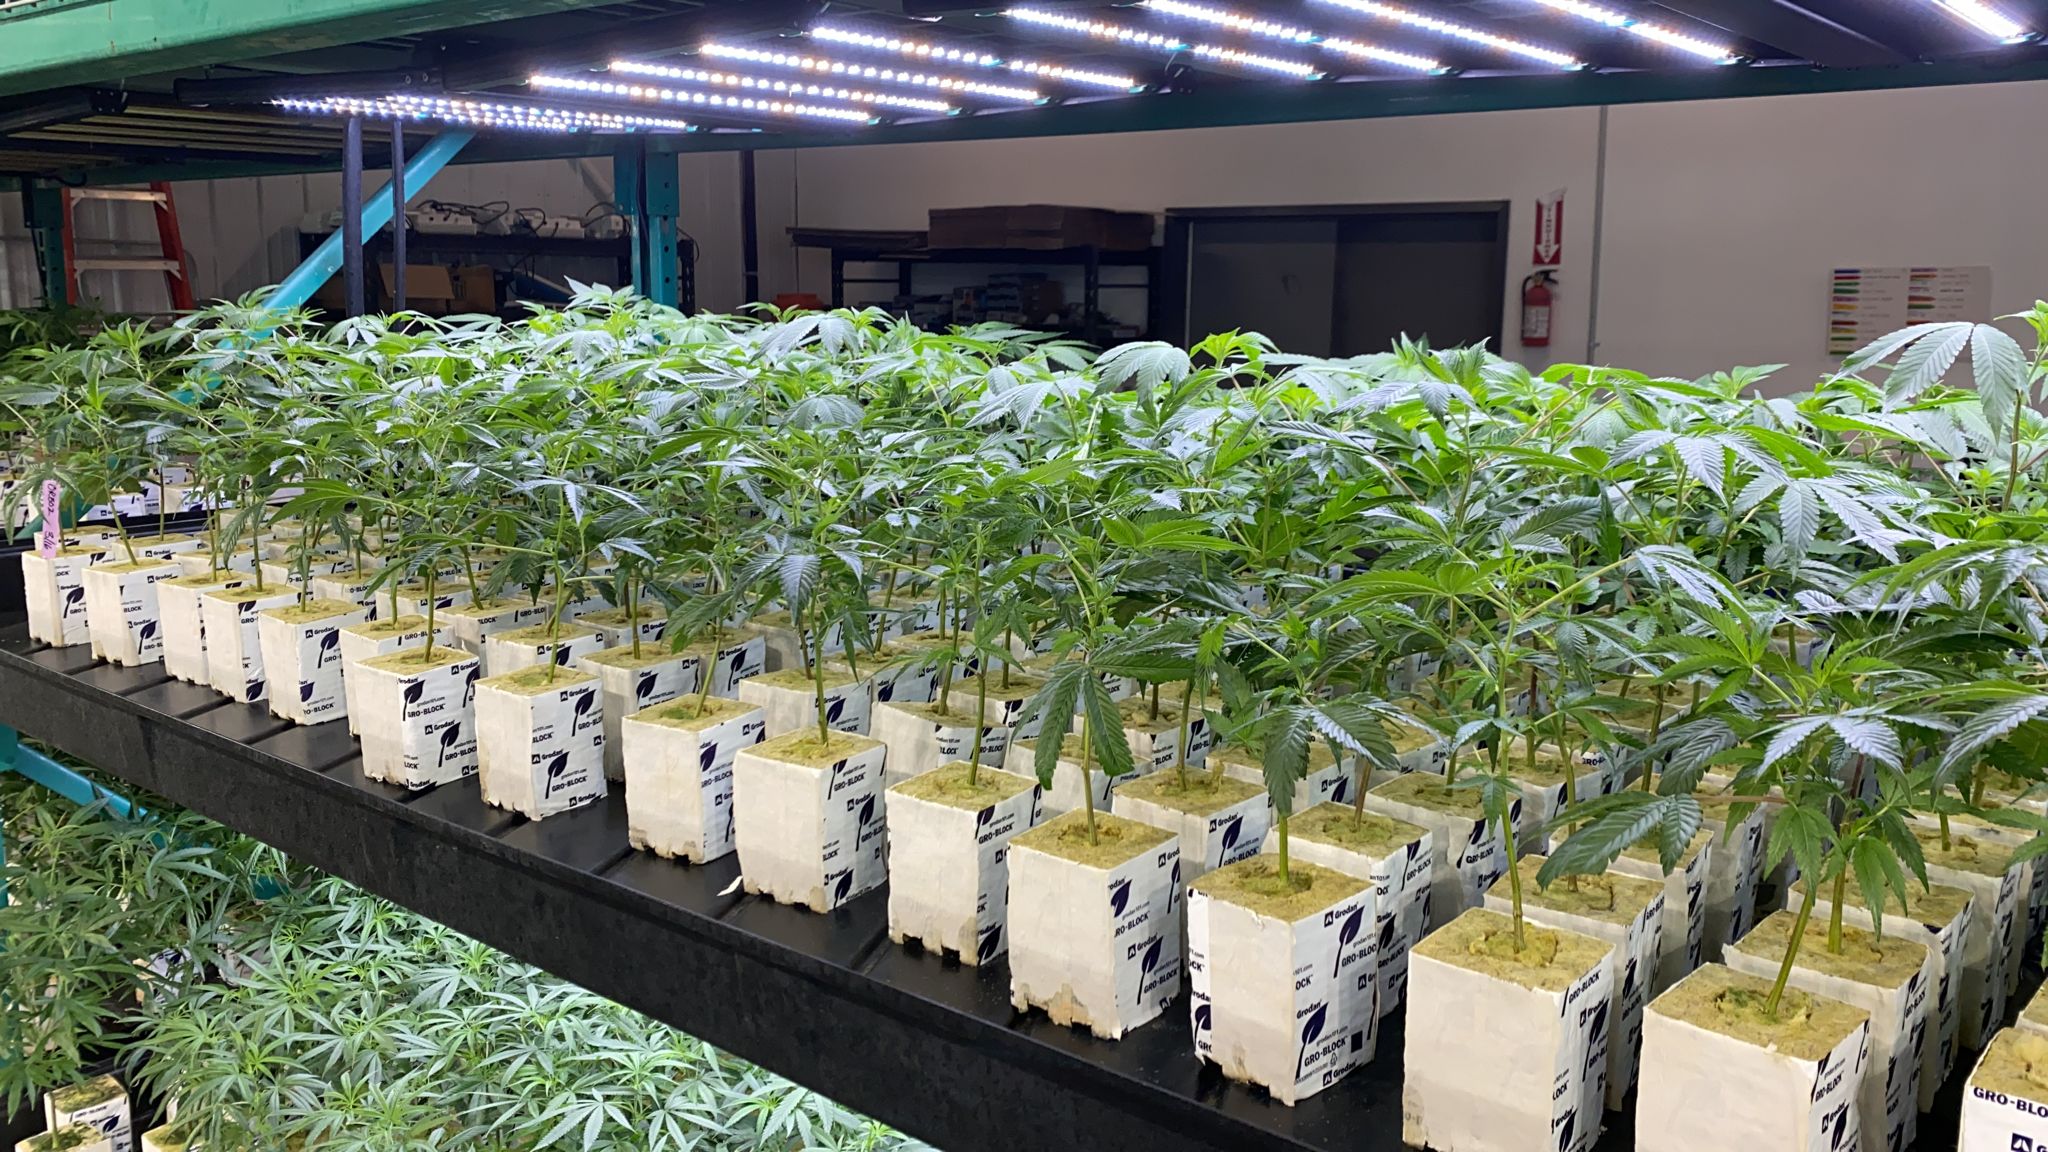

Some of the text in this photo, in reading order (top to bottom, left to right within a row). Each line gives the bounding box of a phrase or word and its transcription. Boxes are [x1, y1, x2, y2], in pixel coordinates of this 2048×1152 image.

[314, 626, 334, 635] Grodan
[404, 628, 441, 640] GRO-BLCK
[460, 661, 479, 671] Grodan
[569, 687, 590, 697] Grodan
[434, 720, 455, 731] Grodan
[542, 750, 563, 760] Grodan
[552, 776, 587, 792] GRO-BLOCK
[834, 773, 865, 791] GRO-BLOCK
[578, 792, 597, 802] Grodan
[1218, 813, 1238, 827] Grodan
[979, 822, 1013, 844] GRO-BLOCK
[1335, 904, 1358, 919] Grodan
[1137, 934, 1157, 951] Grodan
[1144, 969, 1178, 994] GRO-BLOCK
[1569, 971, 1600, 1004] GRO-BLOCK
[1297, 1001, 1321, 1019] Grodan
[1304, 1037, 1346, 1068] GRO-BLOCK
[1333, 1061, 1357, 1078] Grodan
[1973, 1087, 2048, 1118] GRO-BLO
